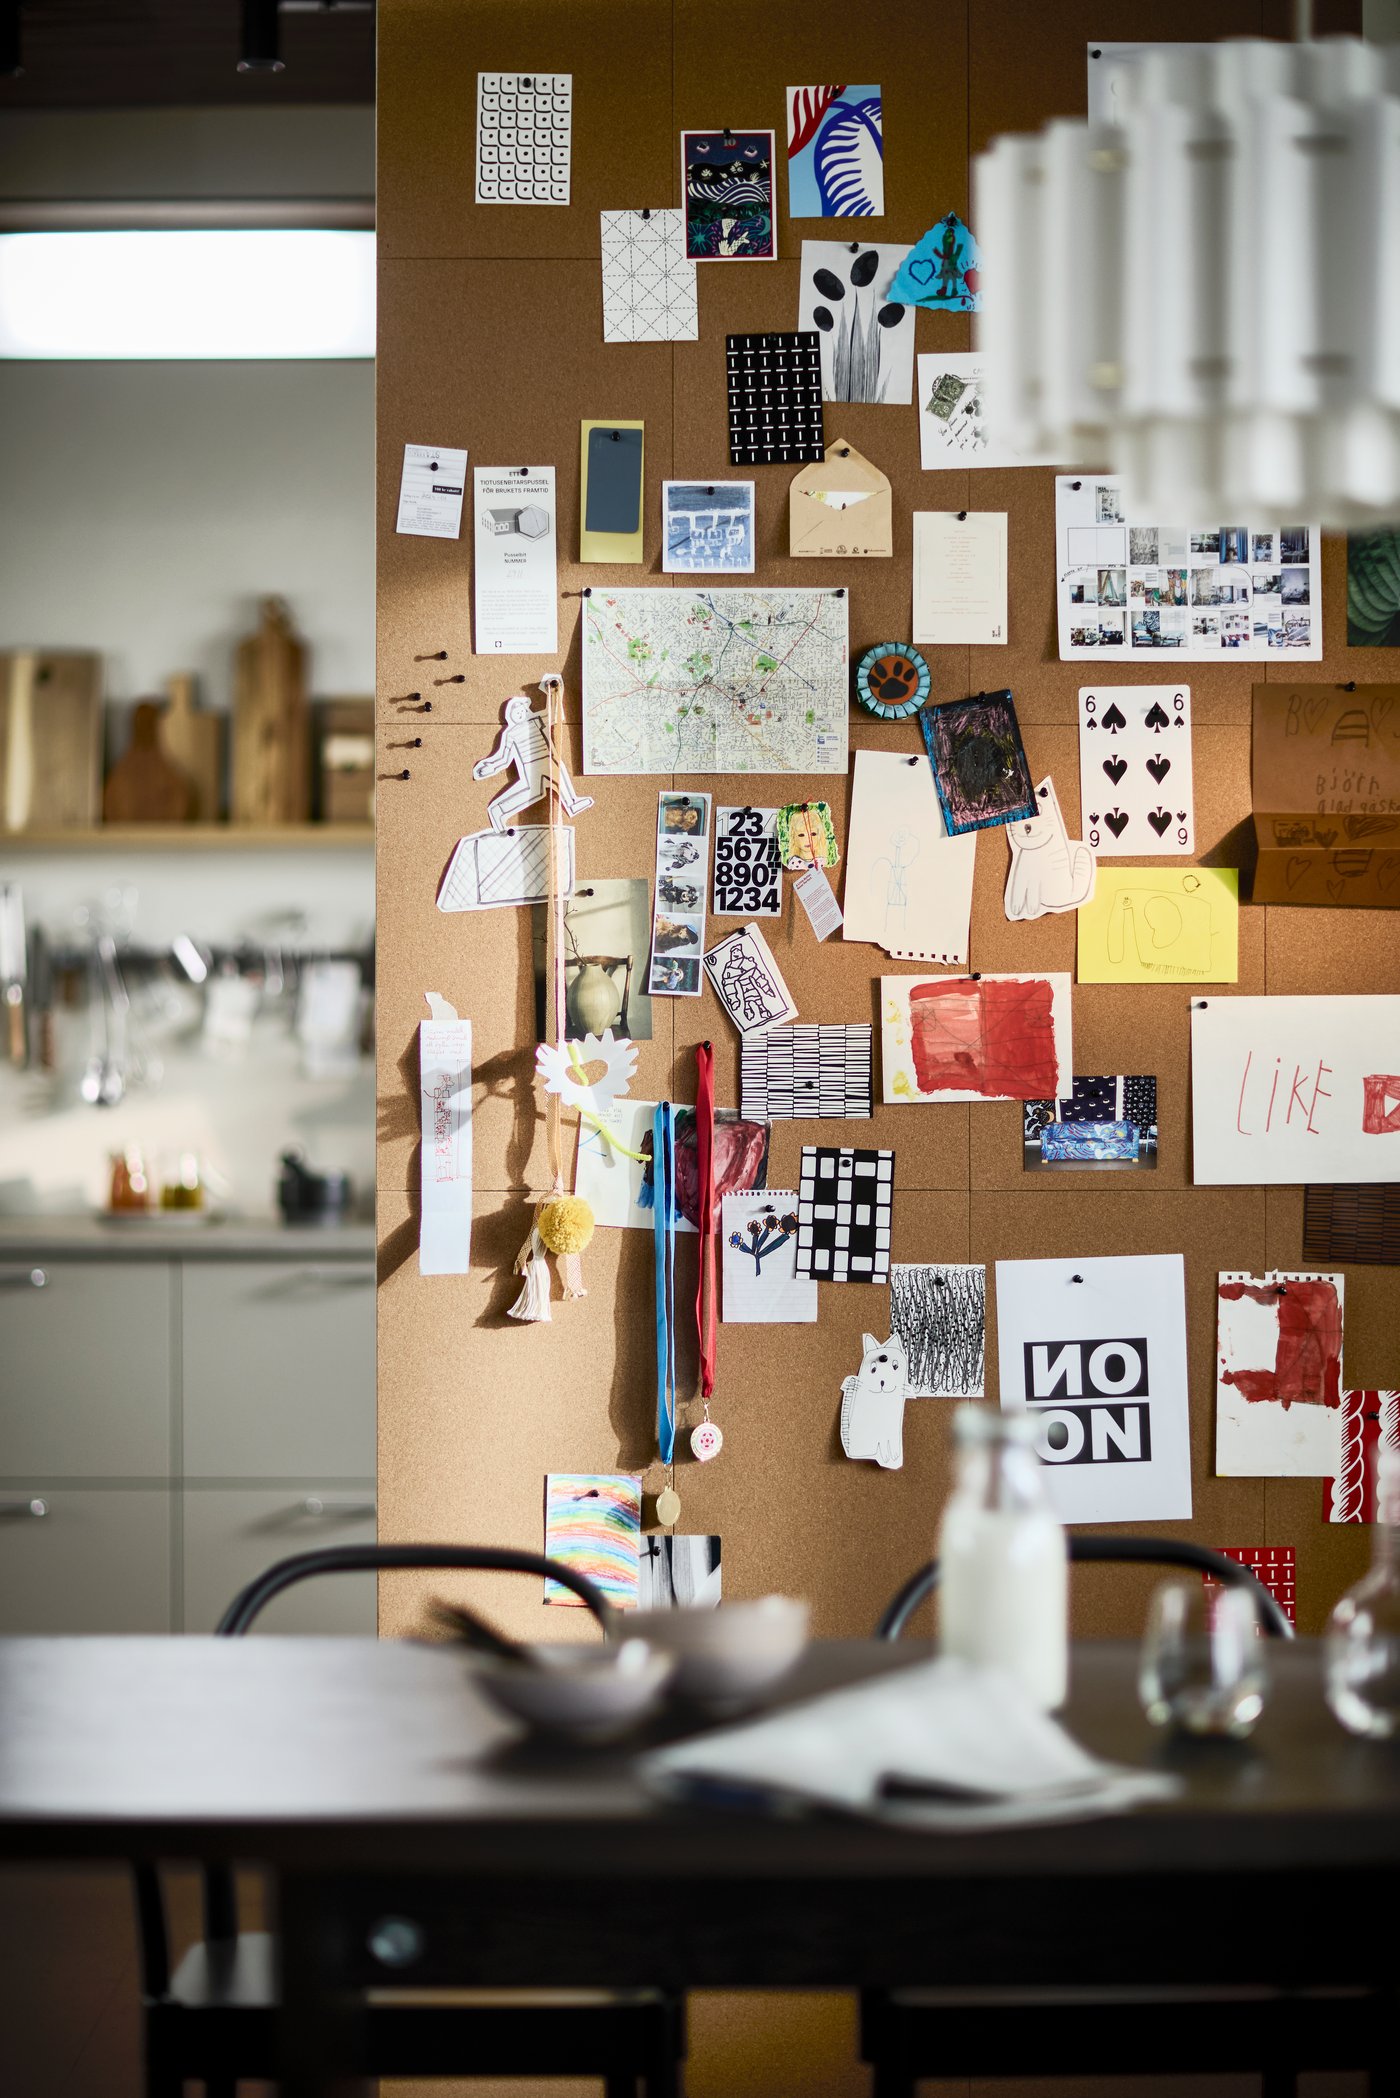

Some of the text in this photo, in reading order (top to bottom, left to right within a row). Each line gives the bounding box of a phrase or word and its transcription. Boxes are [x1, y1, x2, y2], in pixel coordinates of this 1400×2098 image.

[1085, 695, 1097, 713] 6
[1173, 693, 1184, 711] 6
[1315, 767, 1381, 797] Björn
[715, 886, 780, 913] 1234
[1033, 1406, 1142, 1463] ON
